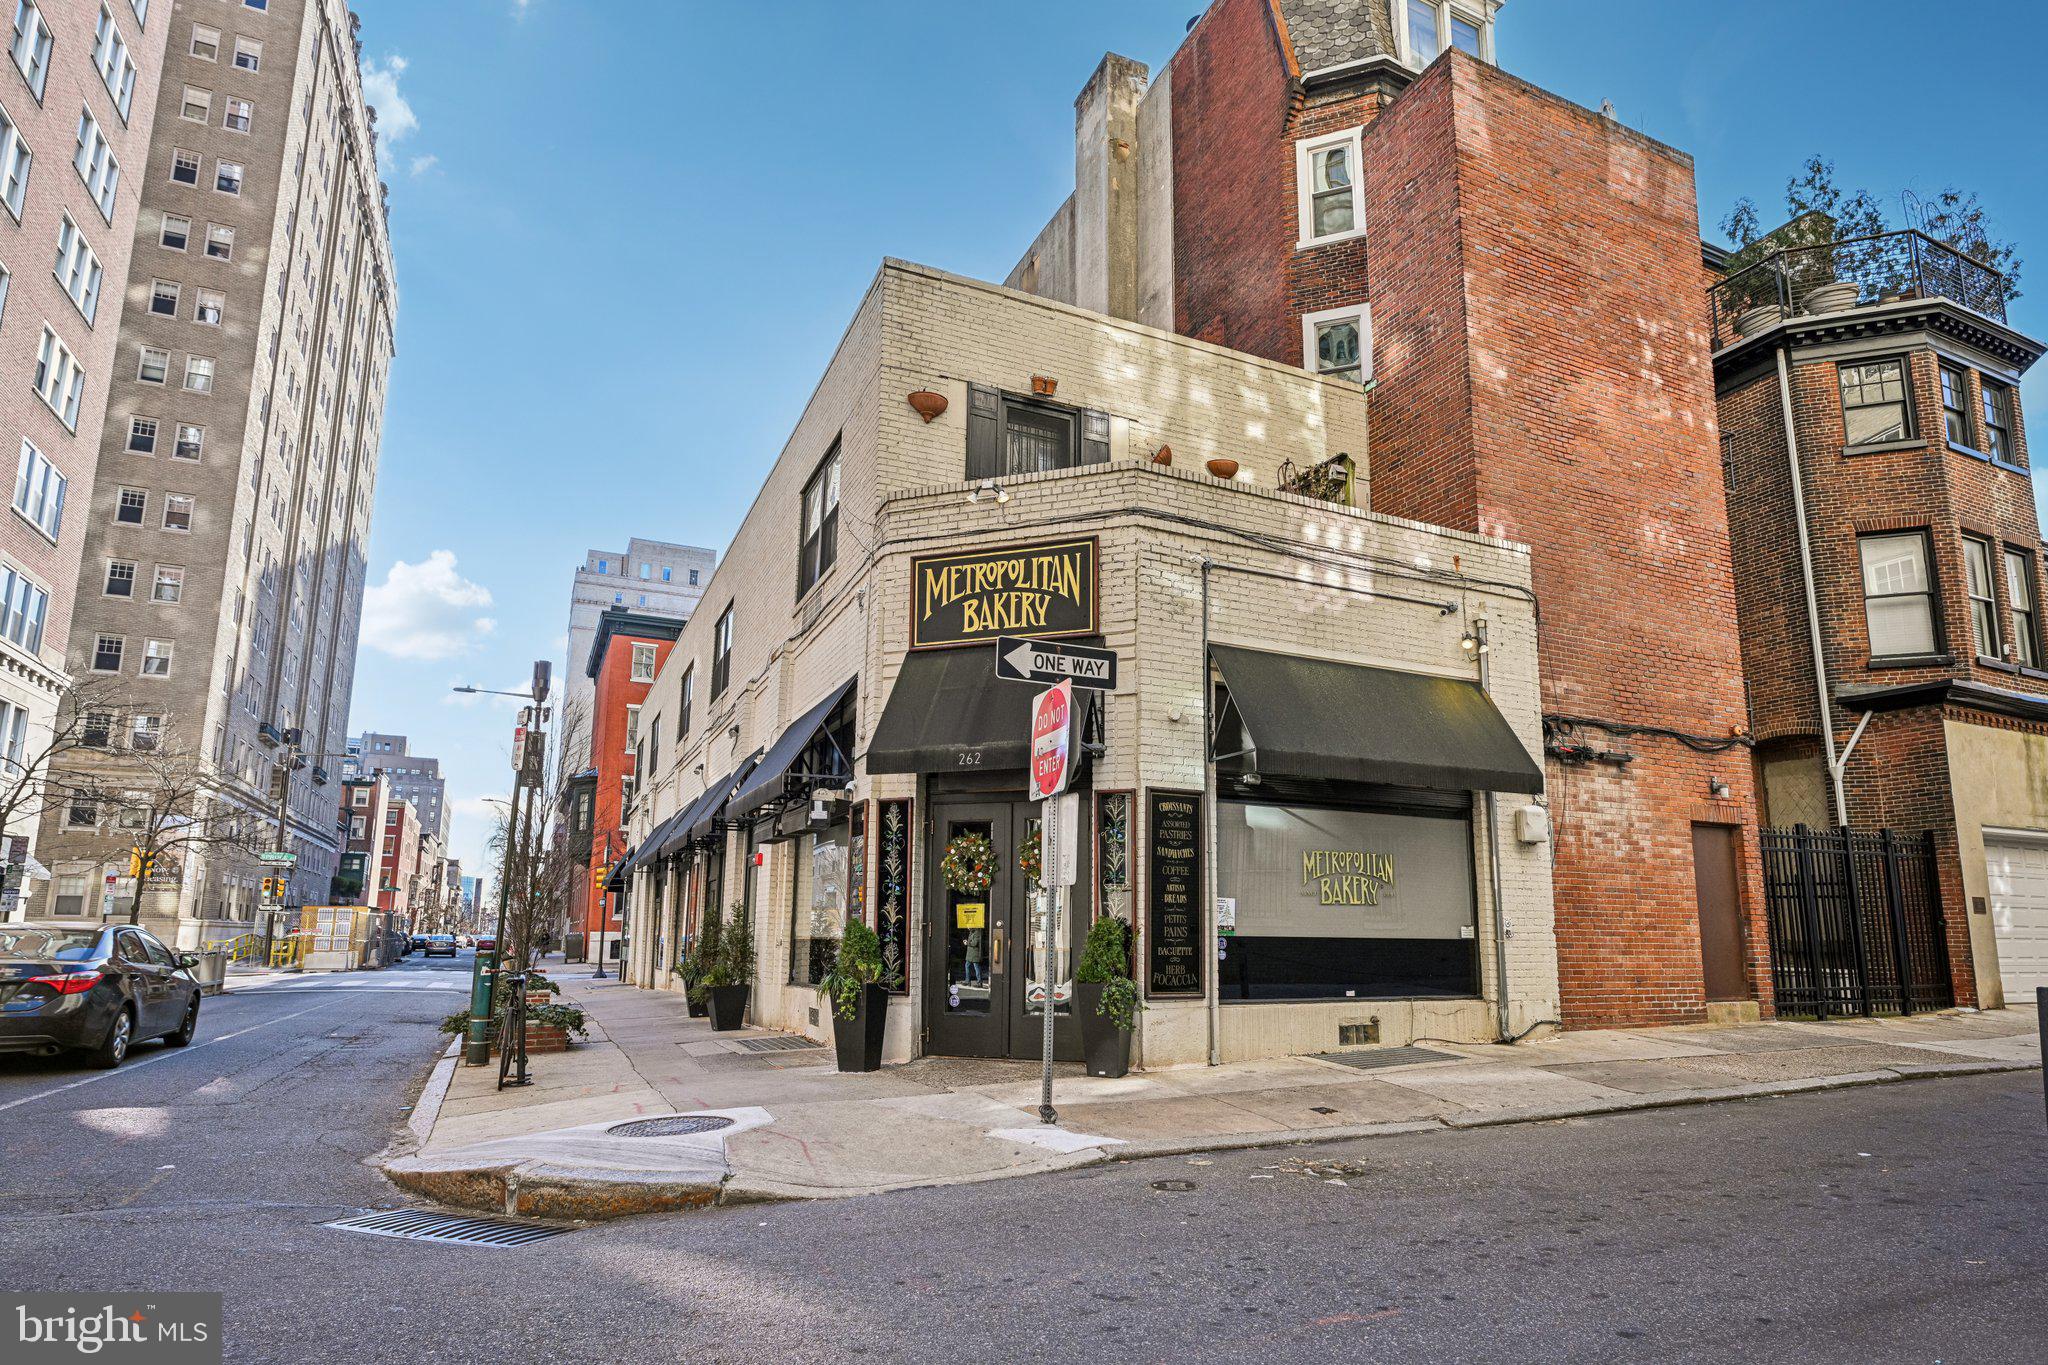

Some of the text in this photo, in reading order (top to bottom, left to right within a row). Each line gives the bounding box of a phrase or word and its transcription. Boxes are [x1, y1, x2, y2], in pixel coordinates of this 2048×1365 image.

[923, 552, 1081, 621] METROPOLITAN
[962, 592, 1051, 633] BAKERY
[1034, 653, 1105, 677] ONE WAY
[1038, 704, 1065, 731] DO NOT
[958, 752, 981, 765] 262
[1039, 755, 1061, 776] ENTER
[1159, 801, 1193, 814] CROISSANTS
[1162, 820, 1190, 829] ASSORTED
[1159, 829, 1192, 840] PASTRIES
[1157, 846, 1195, 859] SANDWICHES
[1162, 865, 1190, 876] COFFEE
[1302, 850, 1395, 888] METROPOLITAN
[1166, 884, 1185, 892] ARTISAN
[1320, 875, 1379, 905] BAKERY
[1164, 893, 1187, 904] BREADS
[1164, 914, 1187, 924] PETITS
[1164, 926, 1188, 937] PAINS
[1158, 946, 1192, 956] BAGUETTE
[1165, 964, 1186, 975] HERB
[1153, 972, 1198, 986] FOCACCIA
